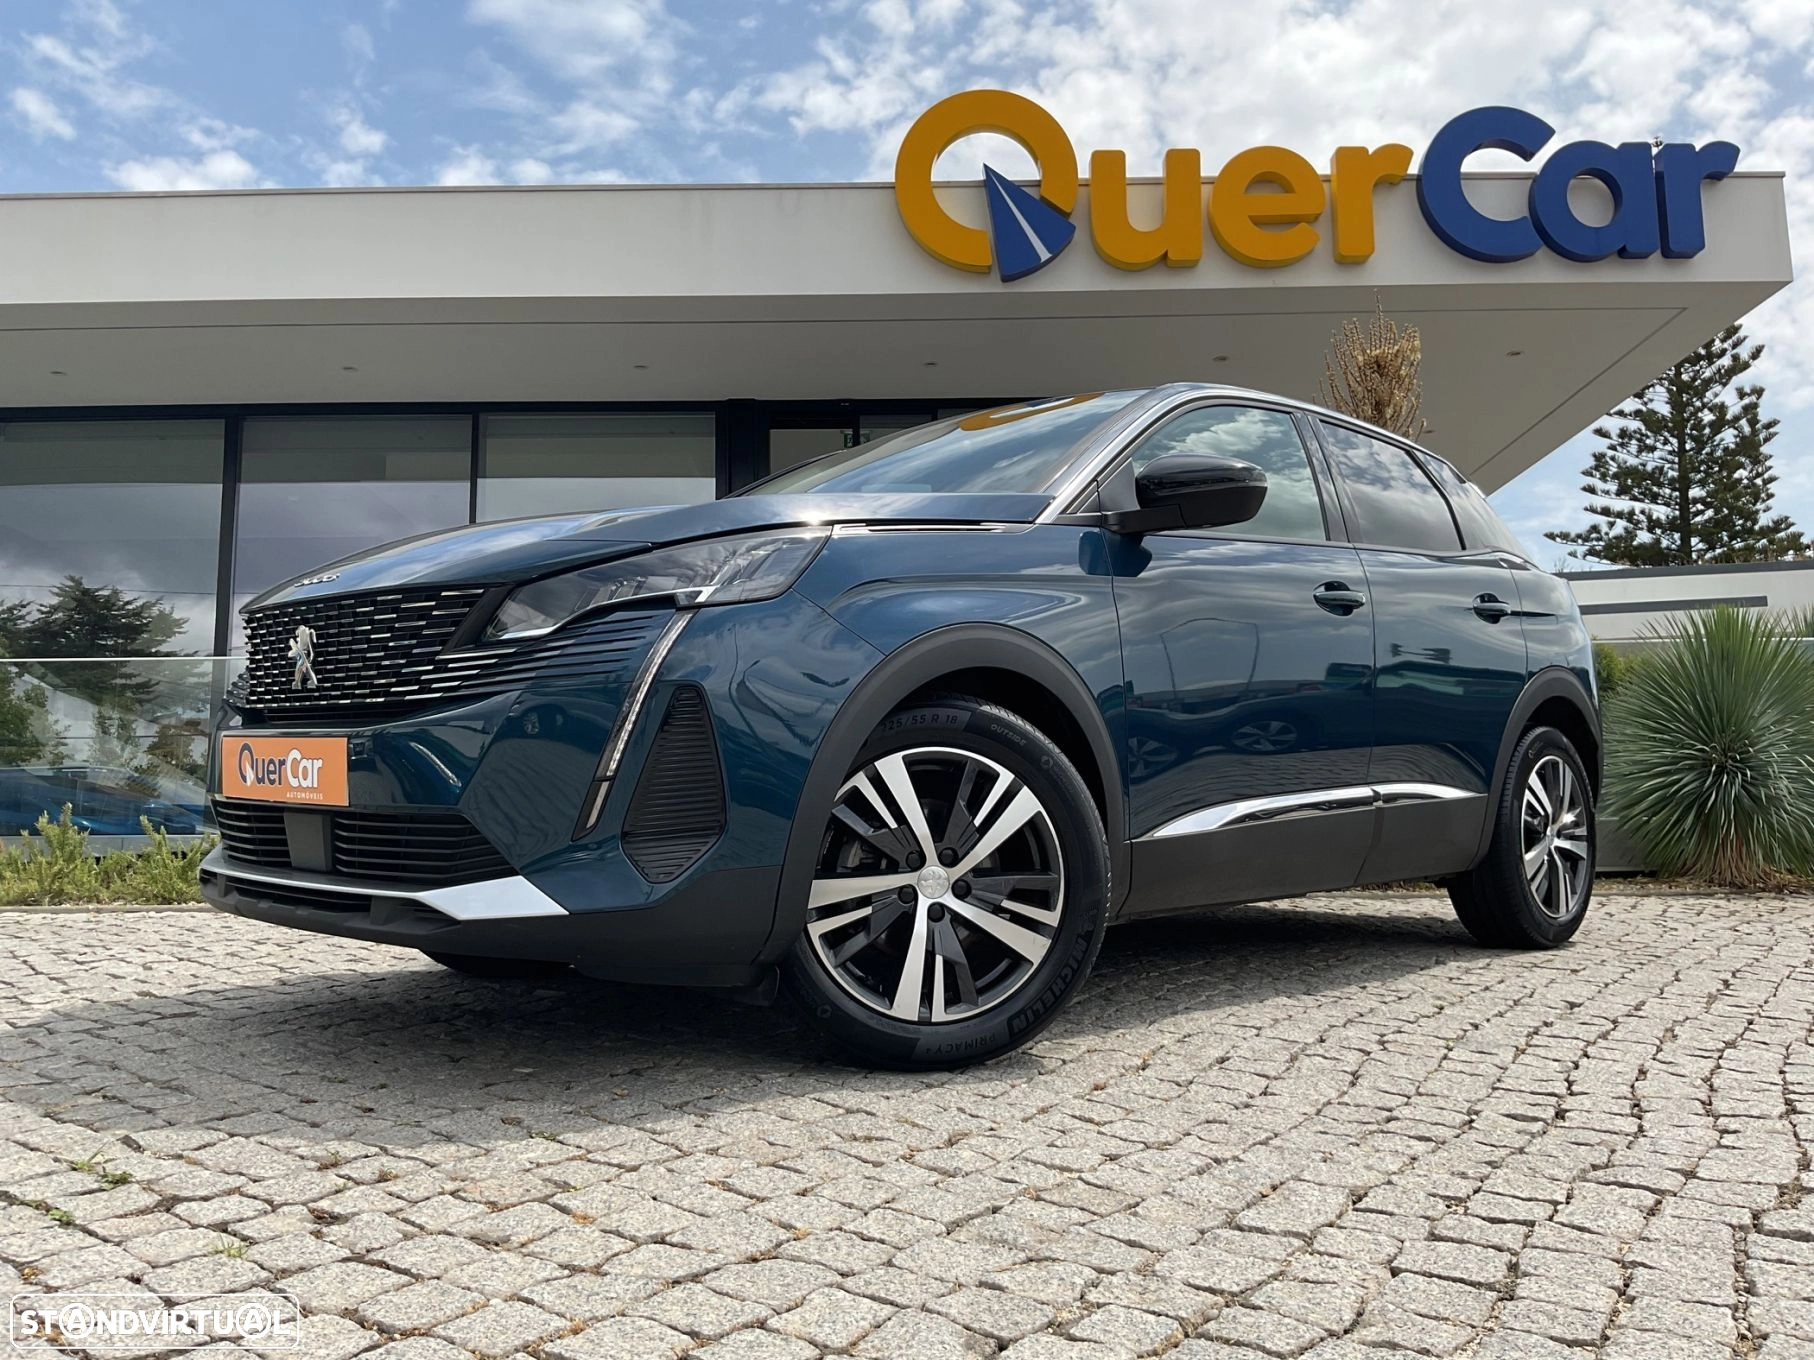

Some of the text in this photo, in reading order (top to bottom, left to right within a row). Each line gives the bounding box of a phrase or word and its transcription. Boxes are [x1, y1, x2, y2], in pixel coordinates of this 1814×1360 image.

[894, 88, 1741, 283] QuerCar
[930, 713, 941, 724] R
[945, 713, 959, 725] 18
[989, 723, 1027, 747] OUTSIDE
[238, 742, 323, 788] QuerCar
[286, 790, 324, 801] AUTOMÓVEIS
[1009, 932, 1091, 1036] MICHELIN
[934, 1032, 996, 1055] PRIMACY
